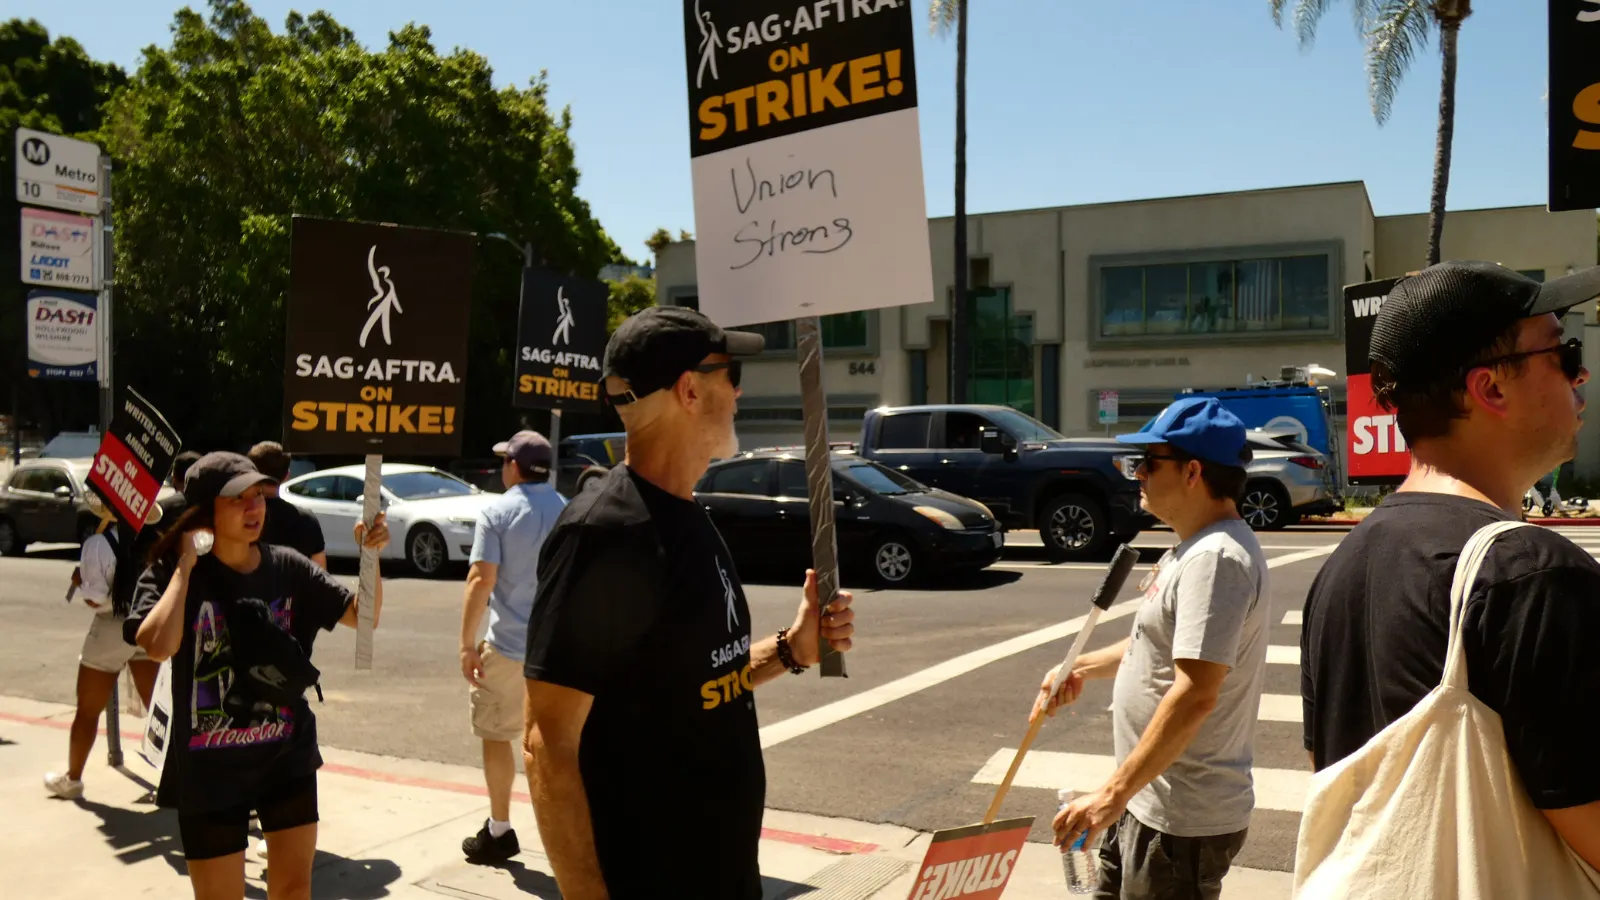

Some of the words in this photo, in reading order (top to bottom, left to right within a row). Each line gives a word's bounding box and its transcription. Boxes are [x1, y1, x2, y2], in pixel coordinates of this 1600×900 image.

[768, 42, 810, 73] ON
[698, 48, 904, 141] STRIKE!
[23, 180, 40, 198] 10
[55, 164, 96, 183] Metro
[731, 157, 838, 214] Union
[730, 218, 852, 270] Strong
[35, 306, 94, 326] DASH
[552, 367, 569, 379] ON
[849, 361, 875, 375] 544
[360, 385, 393, 402] ON
[519, 374, 599, 401] STRIKE!
[125, 400, 156, 436] WRITERS
[155, 431, 174, 456] GUILD
[291, 400, 456, 435] STRIKE!
[125, 432, 154, 469] AMERICA
[124, 460, 138, 480] ON
[95, 454, 148, 519] STRIKE!
[206, 716, 285, 748] Houston
[913, 849, 1017, 900] STRIKE!
